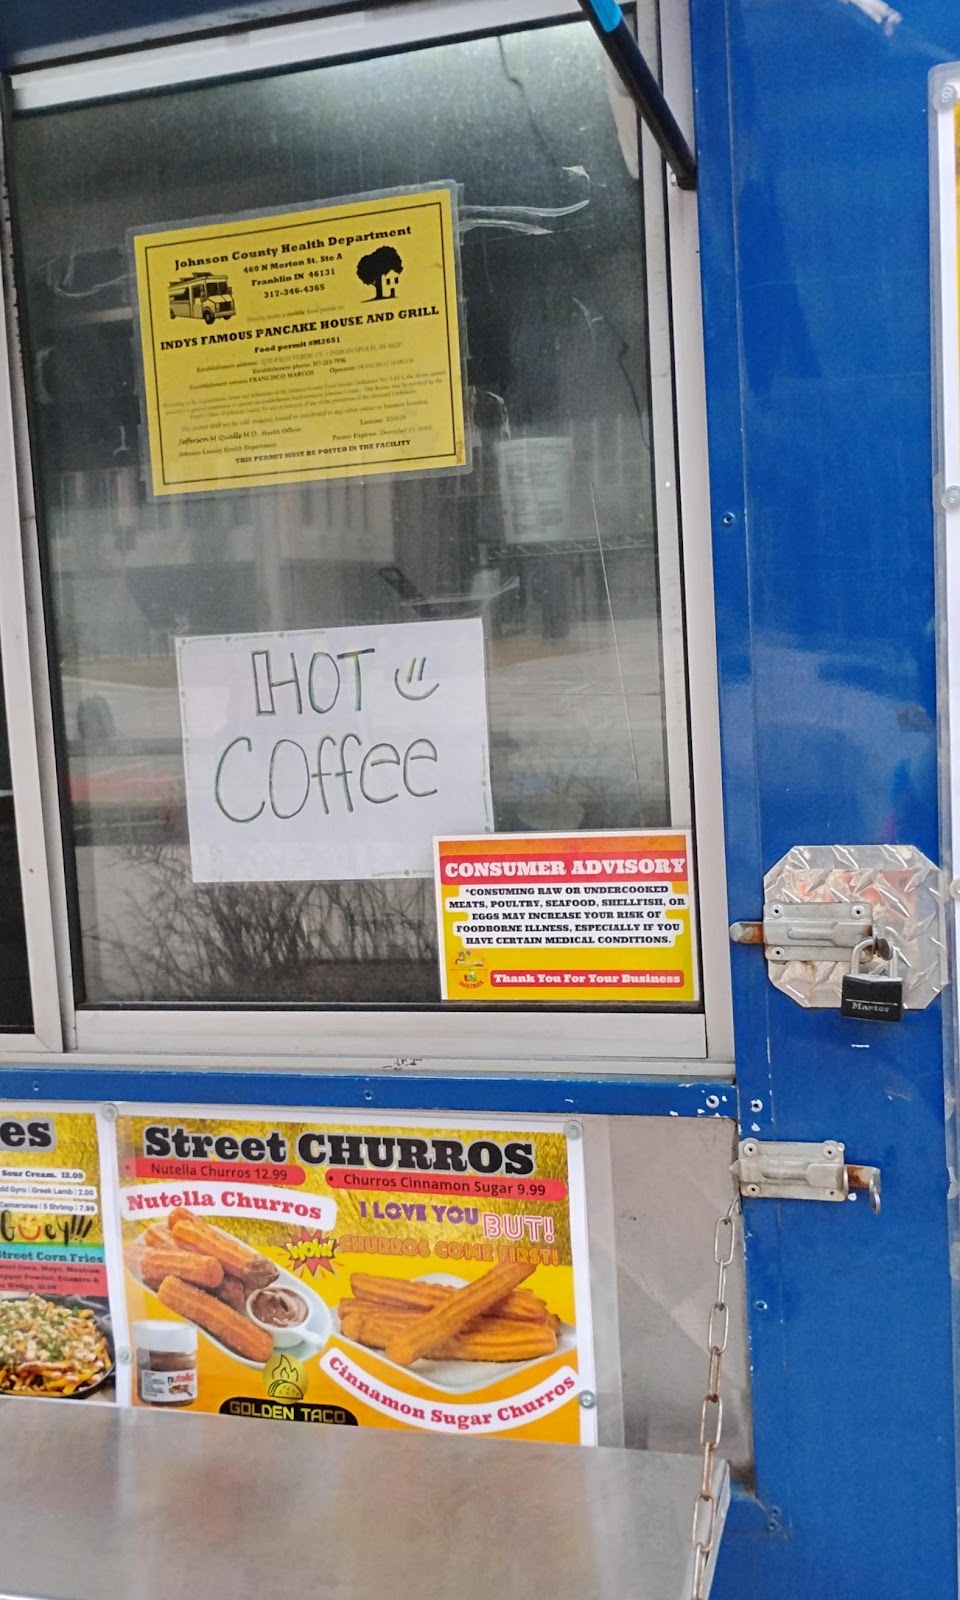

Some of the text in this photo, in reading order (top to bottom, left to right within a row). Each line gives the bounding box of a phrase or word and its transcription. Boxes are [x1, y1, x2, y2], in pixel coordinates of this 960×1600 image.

[175, 226, 412, 271] Johnson County Health Department
[261, 263, 268, 271] N
[270, 259, 305, 270] Morton
[306, 256, 319, 266] St.
[320, 254, 335, 263] Ste
[336, 252, 343, 260] A
[251, 275, 292, 287] Franklin
[308, 268, 336, 279] 46131
[264, 283, 326, 299] 317-346-4365
[160, 306, 440, 351] INDYS FAMOUS PANCAKE HOUSE AND GRILL
[254, 336, 341, 354] Food permit #M2651
[249, 373, 287, 384] FRANCISCO
[287, 370, 315, 379] MARCOS
[254, 453, 283, 462] PERMIT
[284, 451, 305, 459] MUST
[318, 446, 348, 455] POSTED
[360, 443, 374, 451] THE
[376, 440, 411, 449] FACILITY
[252, 648, 376, 717] HOT
[445, 858, 686, 878] CONSUMER ADVISORY
[537, 886, 563, 895] RAW
[565, 886, 581, 895] OR
[584, 885, 669, 895] UNDERCOOKED
[449, 898, 686, 909] MEATS, POULTRY, SEAFOOD, SHELLFISH, OR
[472, 910, 662, 921] EGGS MAY INCREASE YOUR RISK OF
[456, 922, 680, 933] FOODBORNE ILLNESS, ESPECIALLY IF YOU
[465, 935, 672, 945] HAVE CERTAIN MEDICAL CONDITIONS.
[494, 973, 535, 984] Thank
[537, 973, 562, 984] You
[564, 973, 585, 984] For
[586, 973, 620, 984] Your
[621, 973, 681, 984] Business
[852, 1002, 890, 1013] Master
[0, 1122, 52, 1147] es
[145, 1127, 534, 1175] Street CHURROS
[25, 1170, 57, 1178] Cream.
[151, 1163, 288, 1180] Nutella Churros 12.99
[10, 1186, 26, 1194] Gyro
[343, 1173, 546, 1196] Churros Cinnamon Sugar 9.99
[126, 1191, 322, 1220] Nutella Churros
[360, 1201, 556, 1244] I LOVE YOU BUT!
[36, 1251, 67, 1261] Corn
[70, 1253, 104, 1263] Fries
[338, 1234, 560, 1267] CHURROS COME FIRST!
[329, 1356, 576, 1430] Cinnamon Sugar Churros
[229, 1401, 346, 1424] GOLDEN TACO
